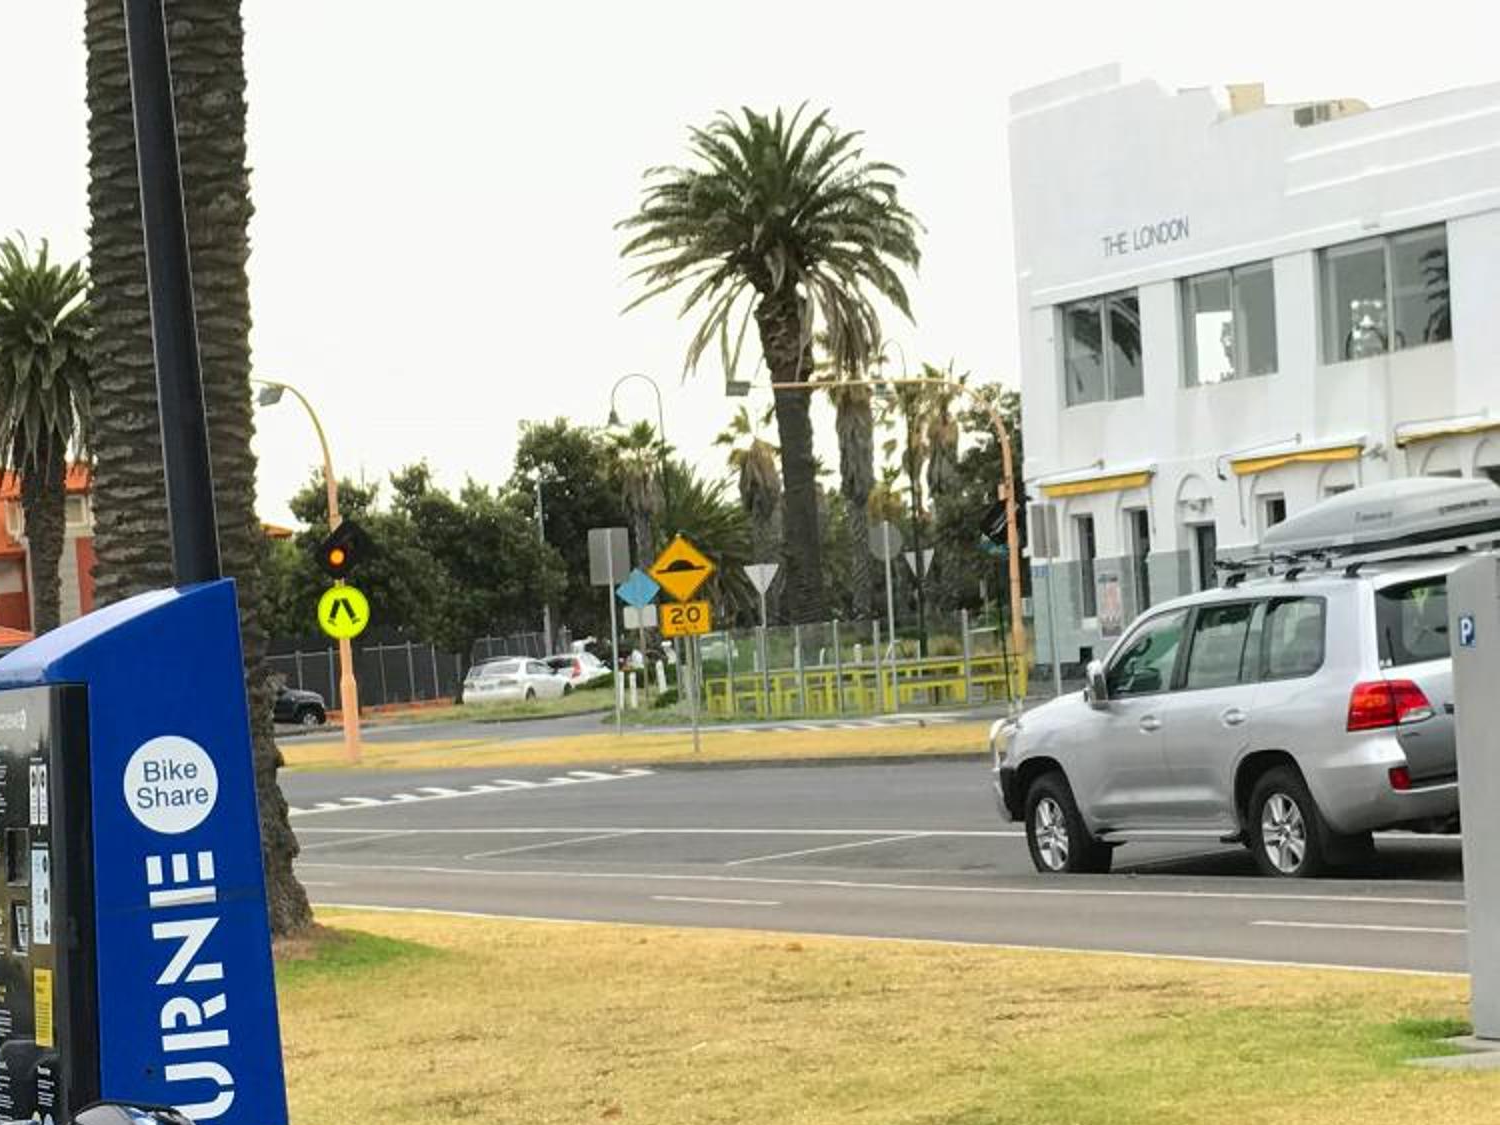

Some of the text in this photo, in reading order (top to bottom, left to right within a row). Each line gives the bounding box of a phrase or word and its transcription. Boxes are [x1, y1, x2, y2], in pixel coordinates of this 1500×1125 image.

[1101, 215, 1188, 257] THE LONDON
[670, 606, 701, 625] 20
[1461, 618, 1472, 644] P
[143, 759, 198, 782] Bike
[137, 787, 209, 809] Share
